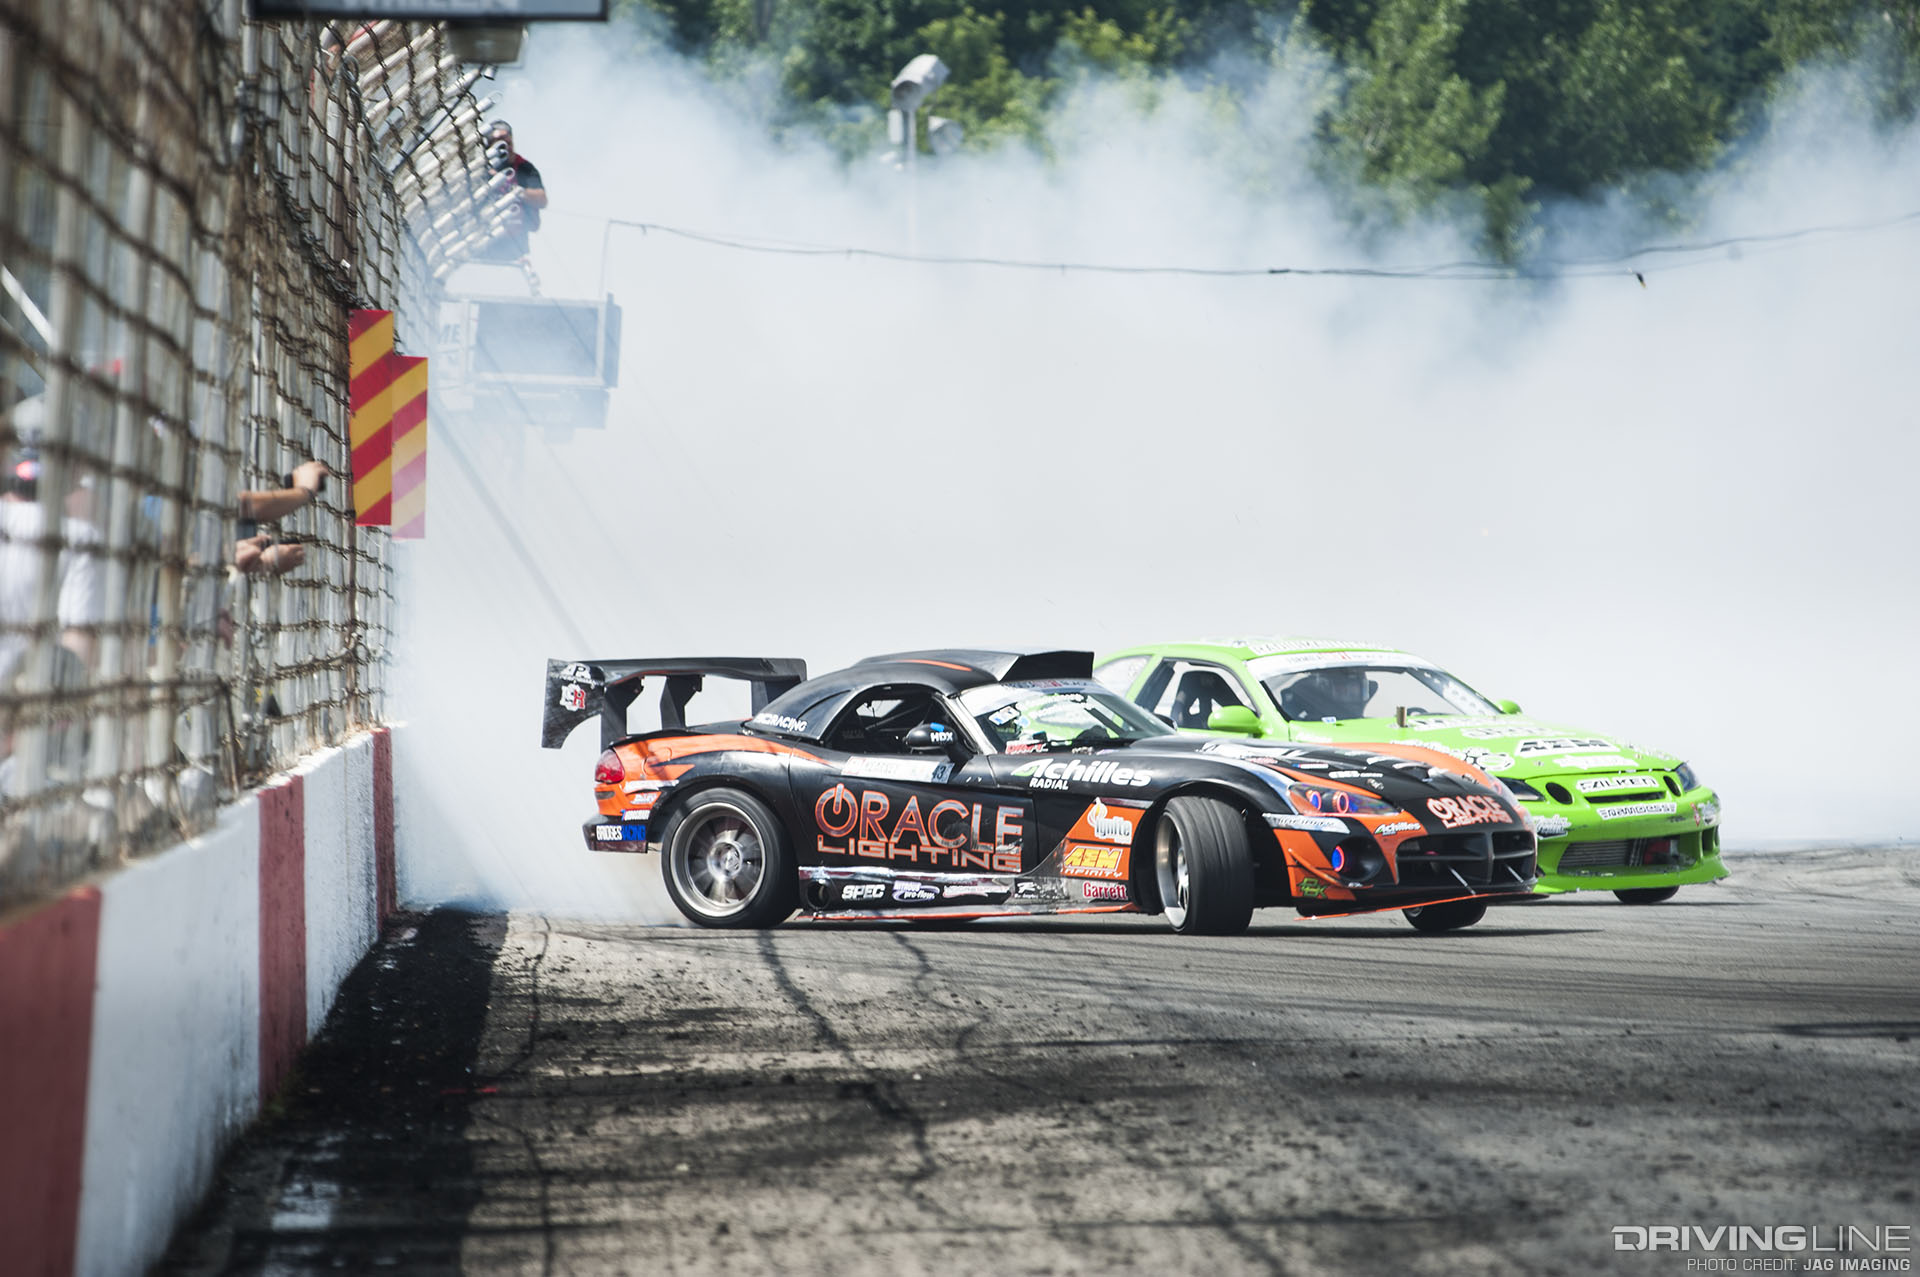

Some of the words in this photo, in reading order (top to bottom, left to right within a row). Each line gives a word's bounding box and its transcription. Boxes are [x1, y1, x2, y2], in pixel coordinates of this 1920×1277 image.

[930, 731, 953, 743] HDX
[1011, 758, 1152, 788] Achilles
[1029, 777, 1069, 791] RADIAL
[814, 783, 1025, 854] ORACLE
[1426, 795, 1503, 820] ORACLE
[817, 834, 1022, 873] LIGHTING
[1064, 845, 1123, 872] AEM
[841, 884, 886, 900] SPEC
[1083, 881, 1128, 900] Garrett
